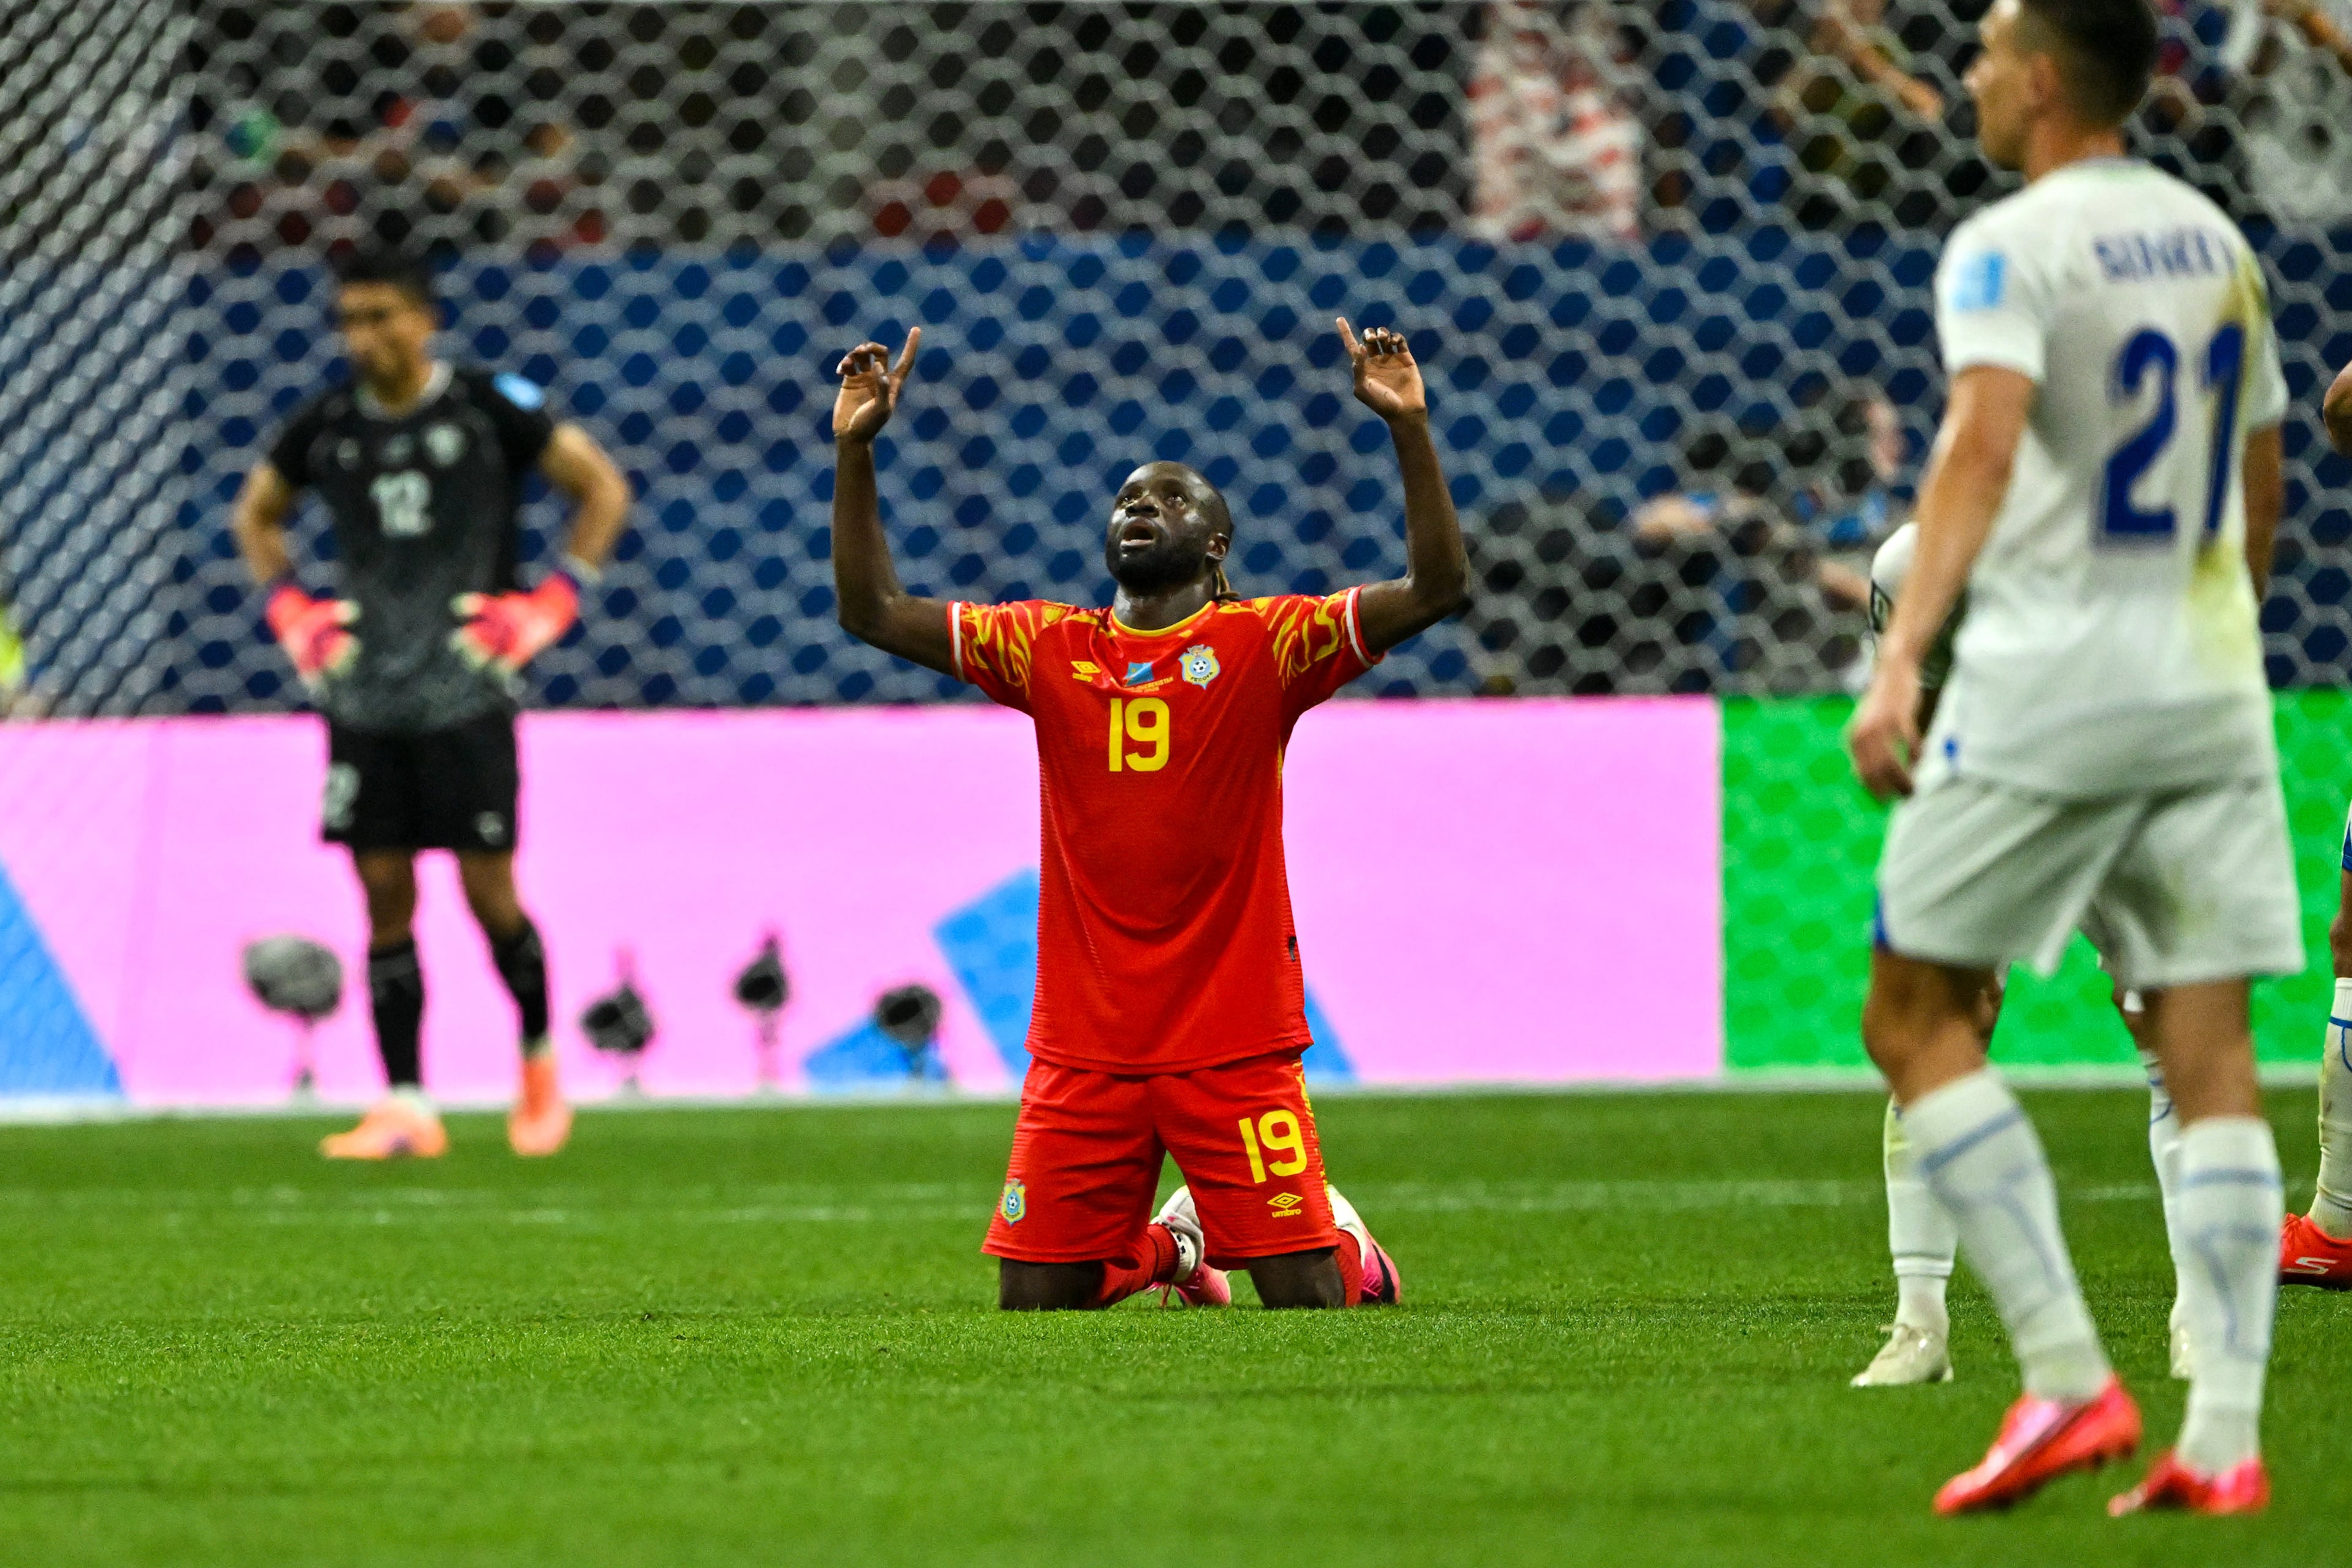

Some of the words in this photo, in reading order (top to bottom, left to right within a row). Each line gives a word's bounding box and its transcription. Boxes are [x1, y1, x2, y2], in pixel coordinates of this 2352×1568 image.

[2097, 323, 2245, 540] 21
[1109, 698, 1170, 772] 19
[1238, 1109, 1308, 1183] 19
[1272, 1208, 1302, 1218] umbro
